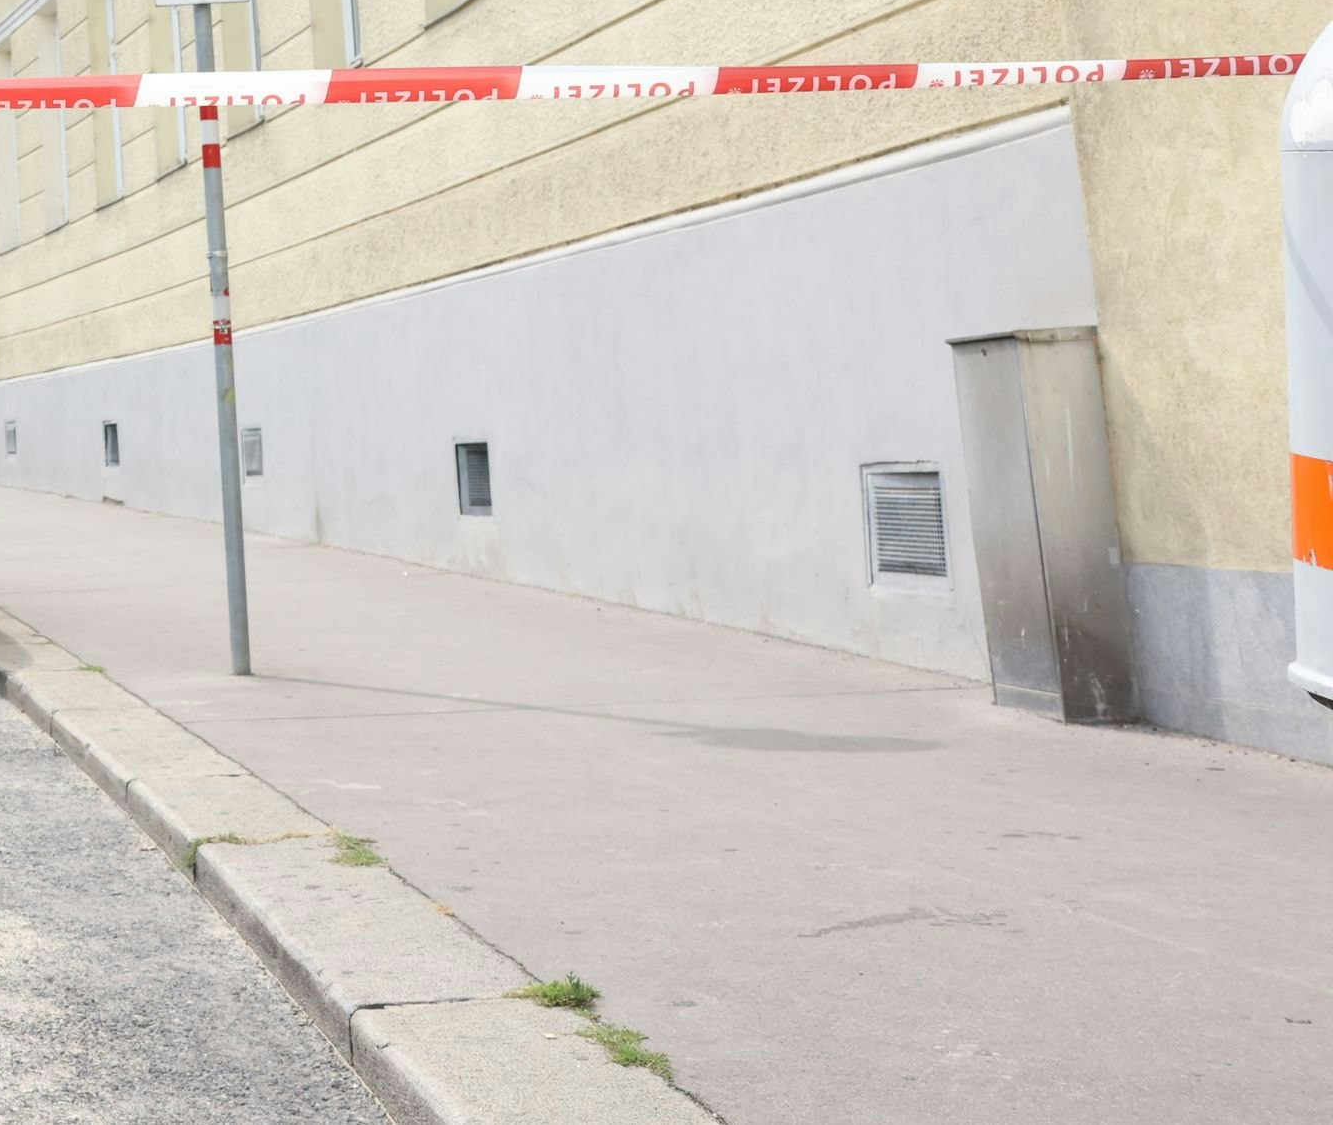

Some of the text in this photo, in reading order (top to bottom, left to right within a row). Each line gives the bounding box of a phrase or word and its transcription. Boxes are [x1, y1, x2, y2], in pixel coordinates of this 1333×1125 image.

[954, 64, 1104, 87] POLIZEI
[1163, 53, 1295, 79] OLIZEI
[553, 81, 695, 99] POLIZEI
[751, 73, 897, 94] POLIZEI
